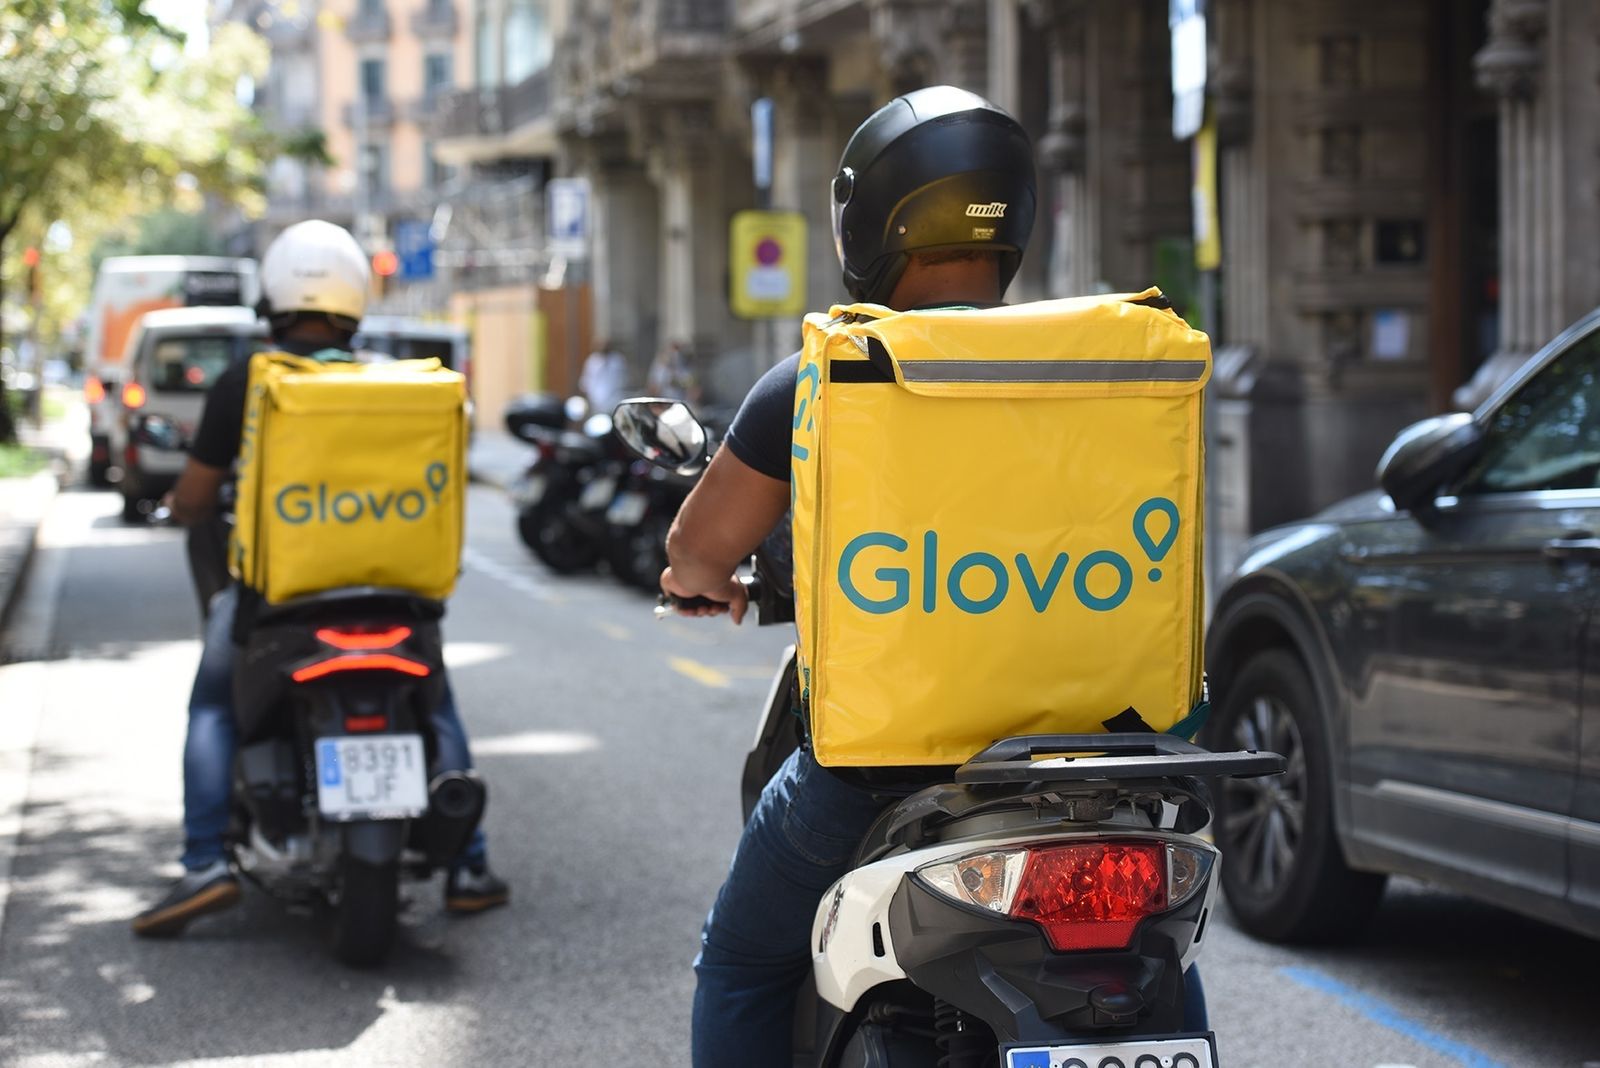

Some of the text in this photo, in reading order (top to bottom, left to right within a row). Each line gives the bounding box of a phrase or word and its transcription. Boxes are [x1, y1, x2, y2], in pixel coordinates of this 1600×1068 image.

[275, 482, 427, 525] Glovo
[838, 530, 1133, 615] Glovo
[344, 742, 414, 774] 8391
